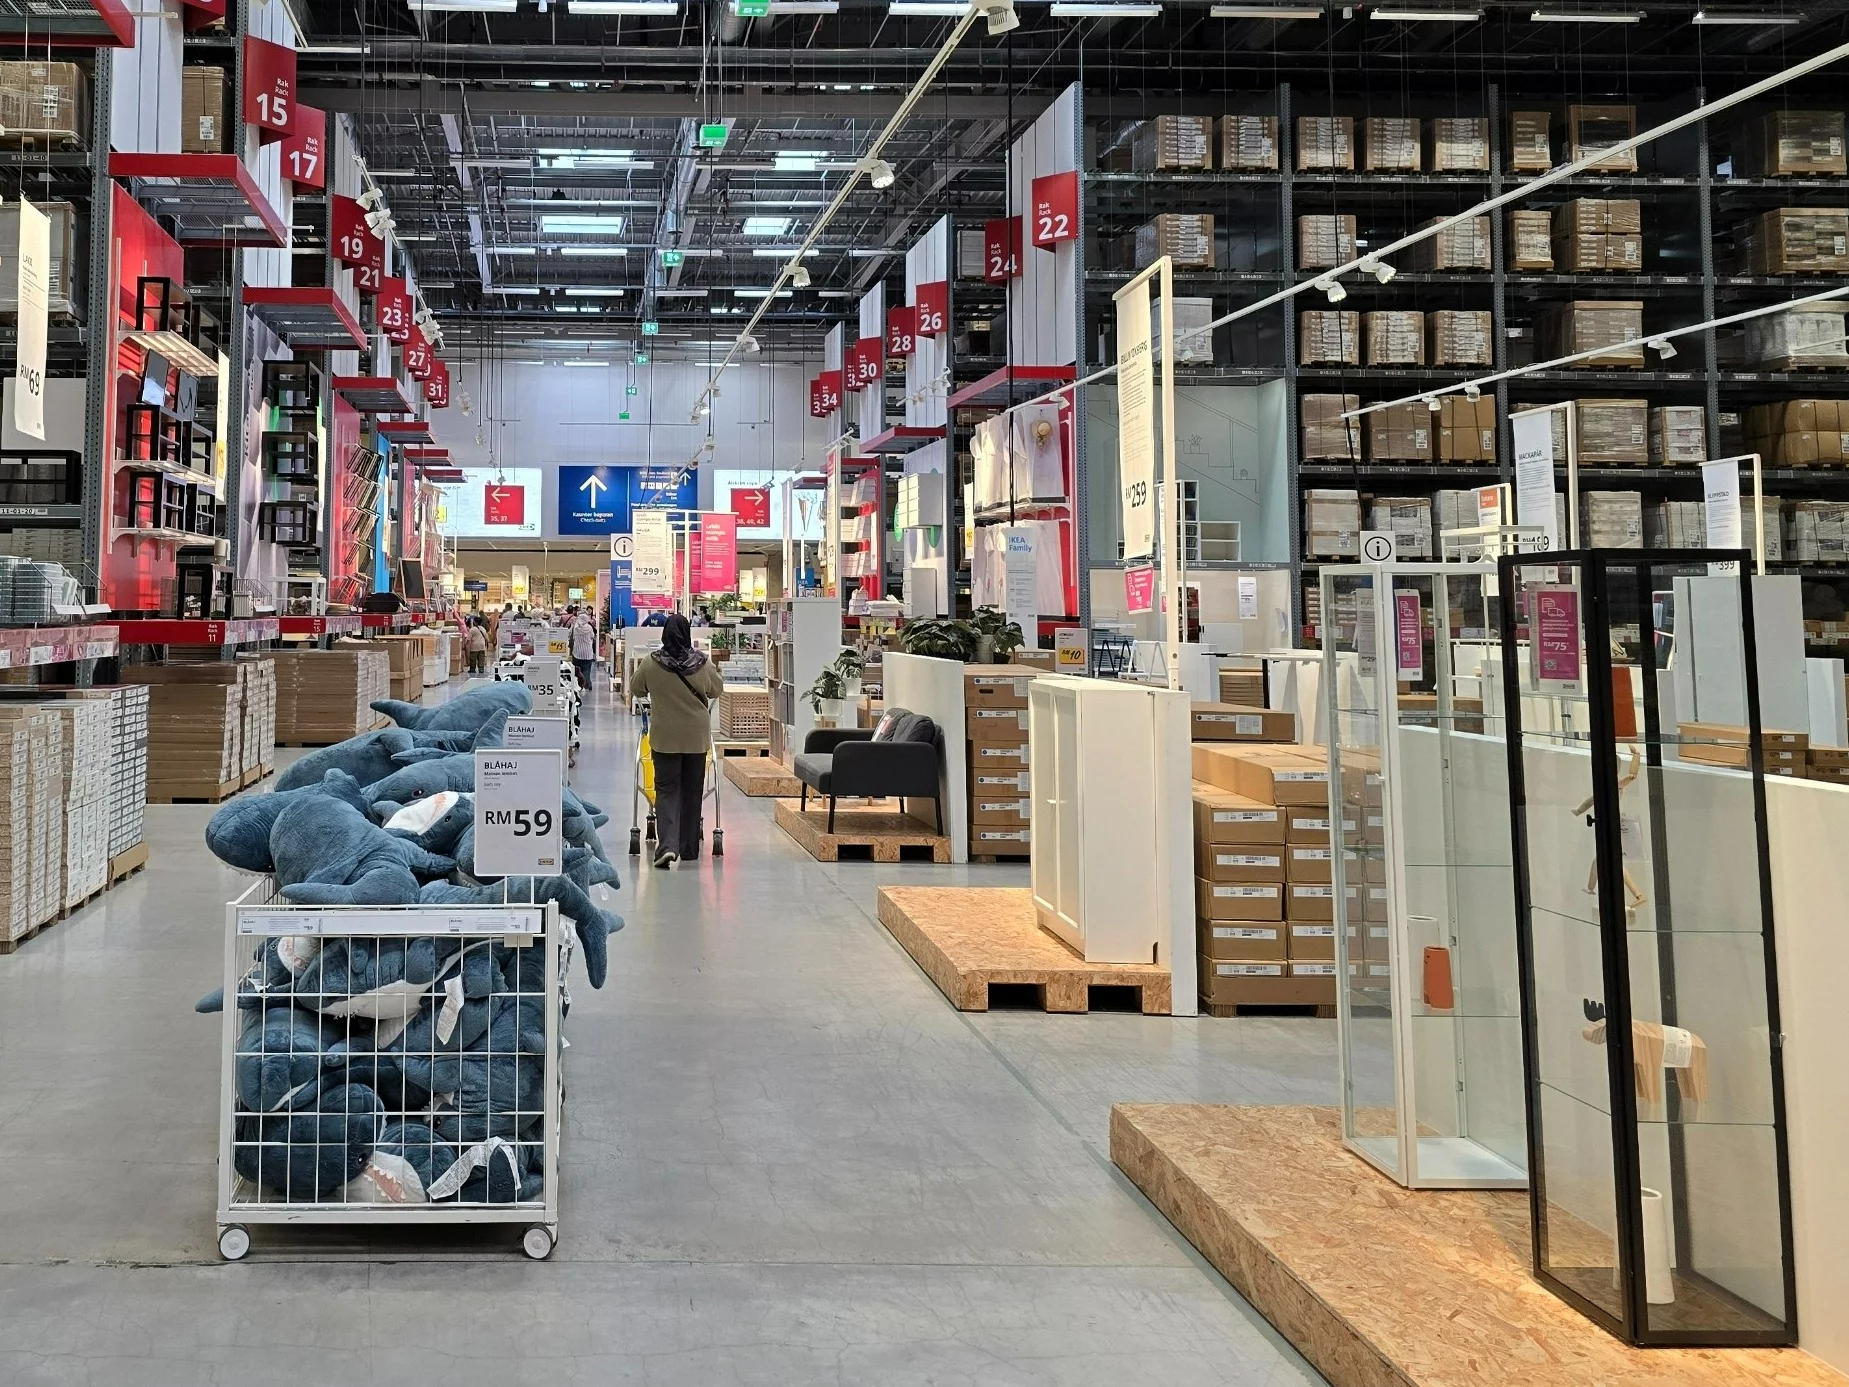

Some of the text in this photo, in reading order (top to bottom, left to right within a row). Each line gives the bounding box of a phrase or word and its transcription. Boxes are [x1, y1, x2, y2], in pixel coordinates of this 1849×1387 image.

[277, 77, 289, 88] Rak
[275, 86, 289, 97] Rack
[256, 93, 288, 126] 15
[305, 144, 318, 153] Rack
[307, 137, 319, 146] Rak
[289, 151, 318, 179] 17
[1038, 202, 1050, 210] Rak
[1038, 214, 1069, 241] 22
[340, 235, 363, 259] 19
[990, 253, 1018, 277] 24
[359, 266, 380, 288] 21
[382, 306, 402, 326] 23
[920, 312, 942, 332] 26
[891, 335, 912, 353] 28
[408, 350, 425, 367] 27
[859, 362, 877, 379] 30
[20, 364, 41, 396] RM69
[428, 383, 442, 398] 31
[821, 392, 838, 407] 34
[1125, 480, 1147, 508] RM259
[1008, 536, 1026, 544] IKEA
[1009, 544, 1033, 553] Family
[208, 634, 216, 642] 11
[1061, 649, 1081, 660] RM10
[484, 760, 518, 770] BLÅHAJ
[485, 809, 553, 837] RM59
